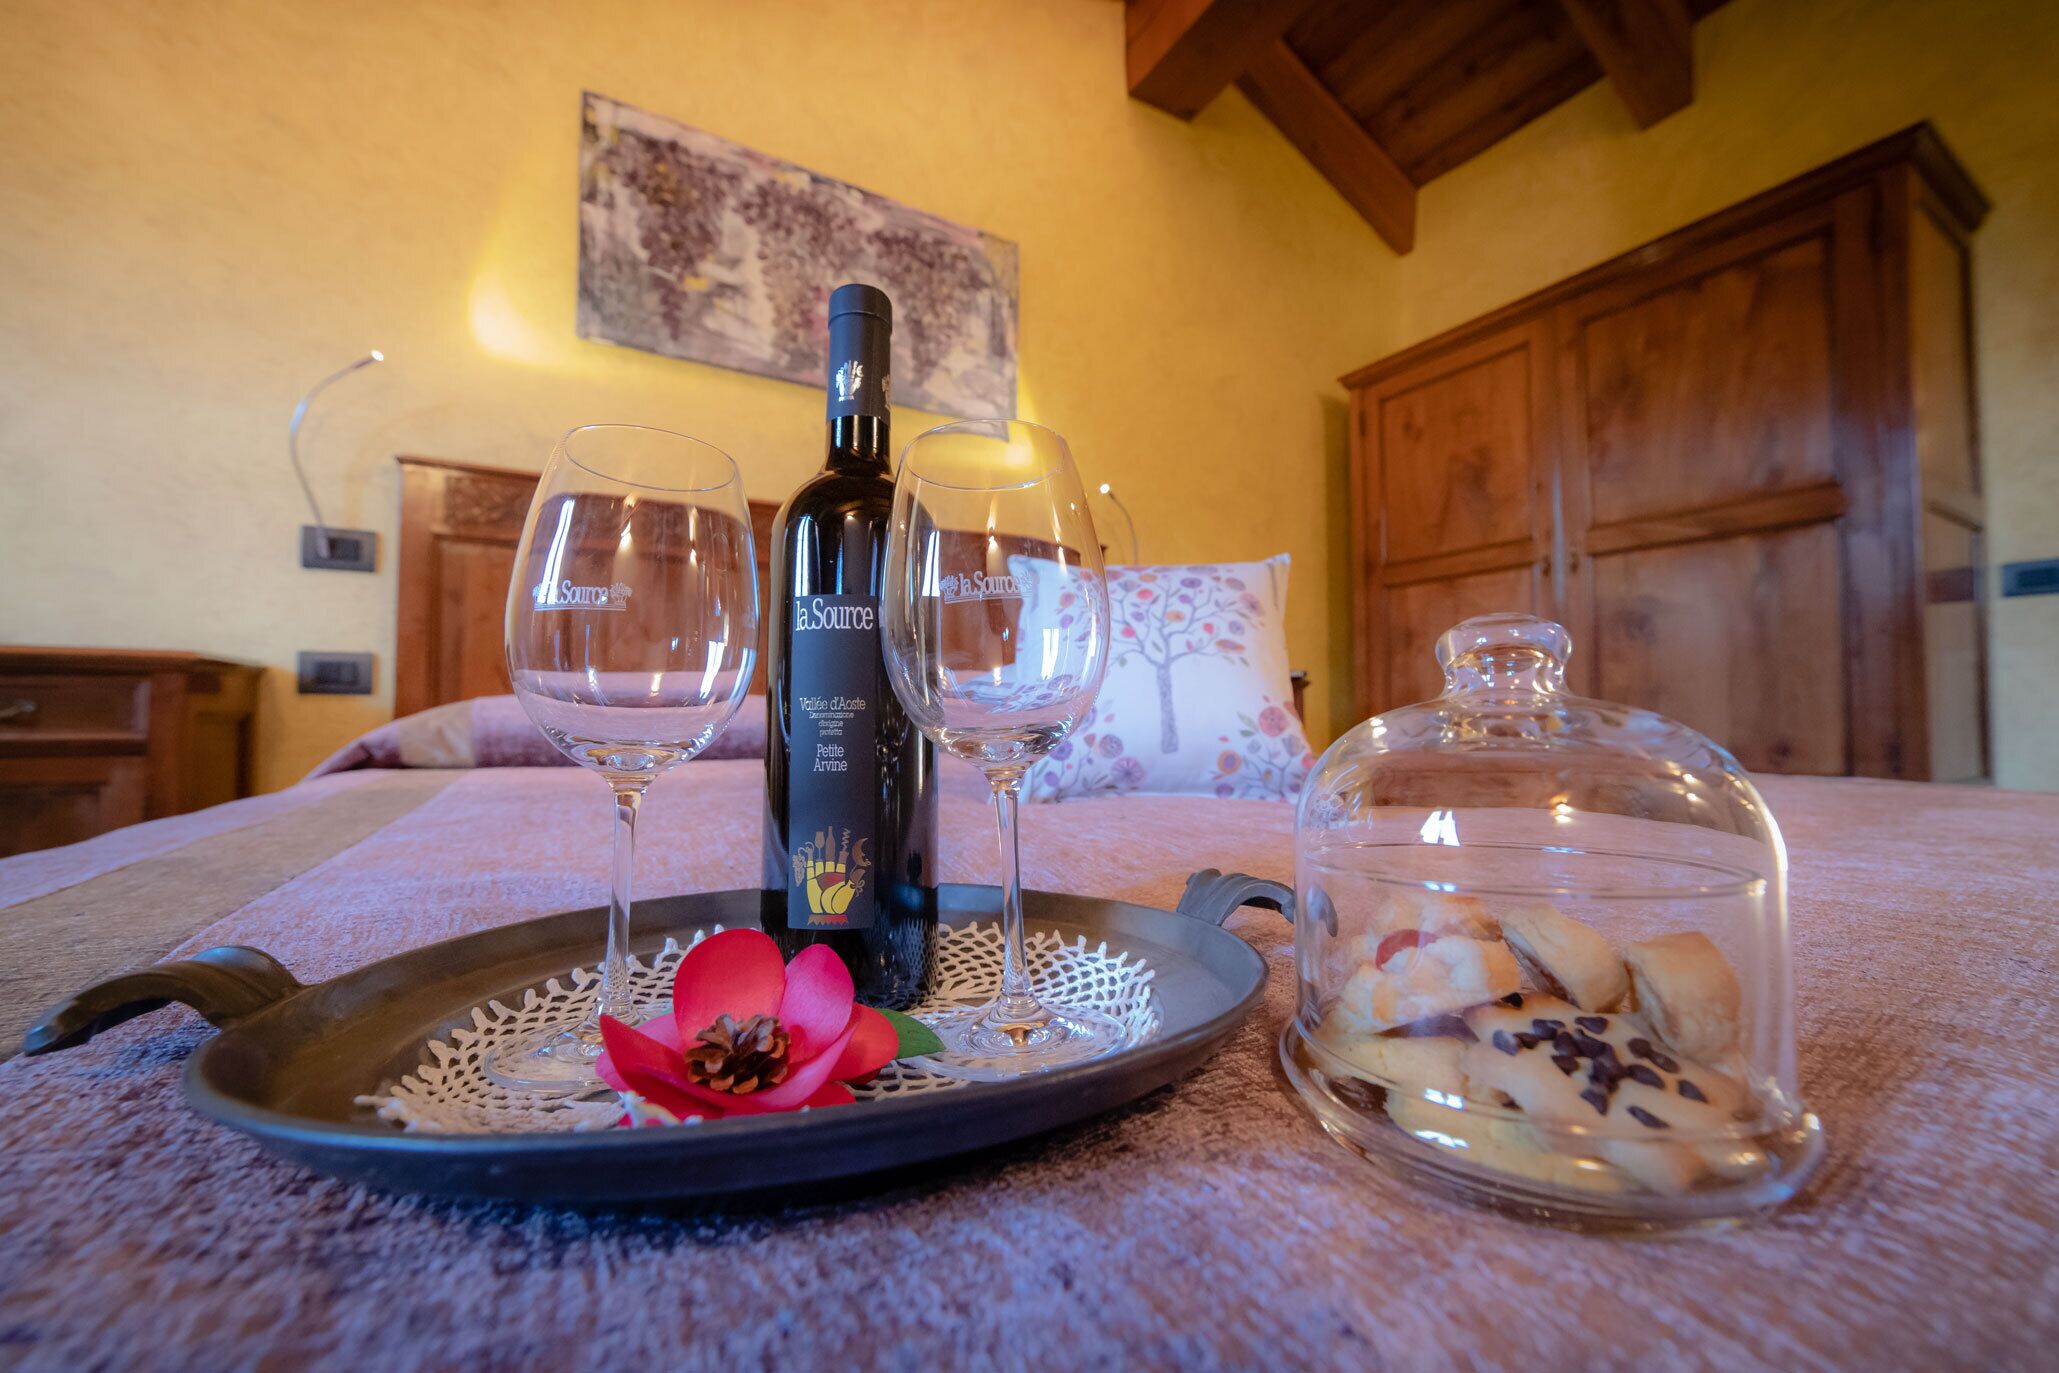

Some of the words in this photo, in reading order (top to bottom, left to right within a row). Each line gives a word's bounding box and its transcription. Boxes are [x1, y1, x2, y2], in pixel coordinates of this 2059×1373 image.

[812, 598, 874, 630] Source
[799, 696, 828, 711] Vallée
[830, 697, 866, 711] d'Aoste
[816, 744, 845, 757] Petite
[813, 758, 848, 772] Arvine
